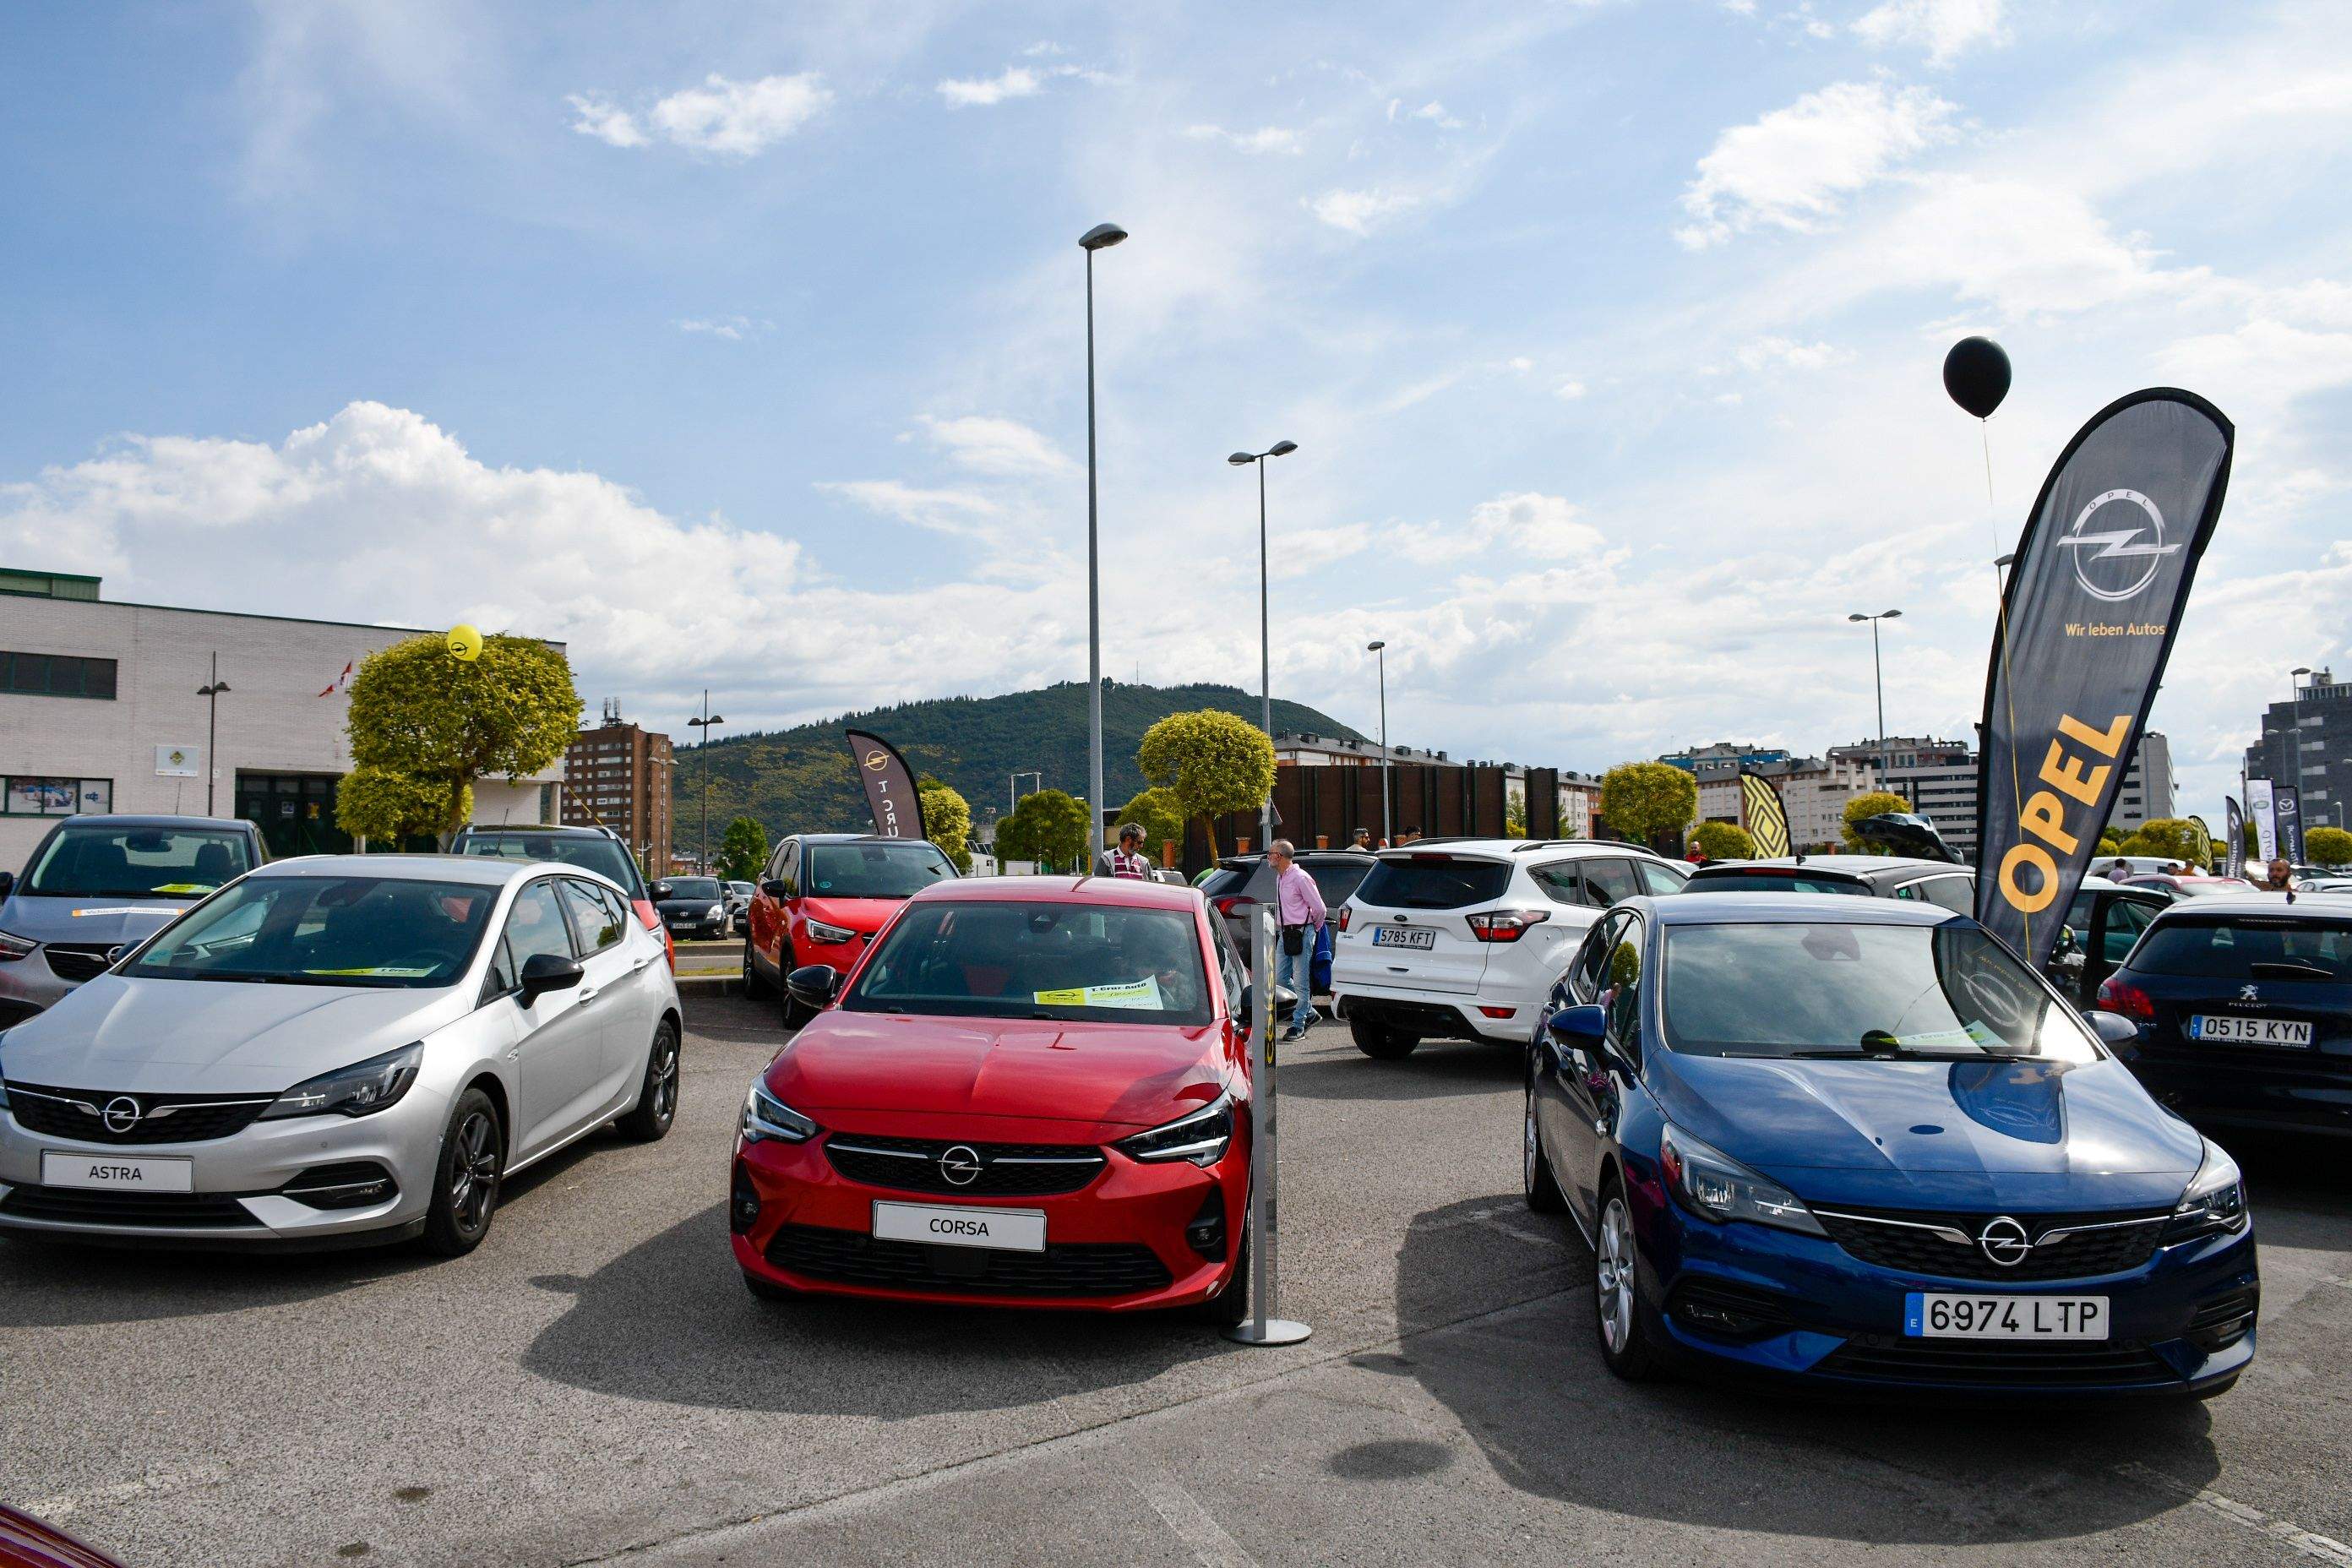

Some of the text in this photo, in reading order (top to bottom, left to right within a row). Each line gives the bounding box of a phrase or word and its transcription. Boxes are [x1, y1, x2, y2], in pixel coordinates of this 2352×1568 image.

[2089, 491, 2149, 510] OPEL
[2066, 623, 2165, 636] Wir leben Autos
[1999, 714, 2132, 912] OPEL
[1381, 931, 1431, 945] 5785 KFT
[2206, 1018, 2308, 1042] 0515 KYN
[89, 1166, 142, 1180] ASTRA
[930, 1218, 989, 1236] CORSA
[1910, 1319, 1918, 1327] E
[1930, 1300, 2098, 1333] 6974 LTP
